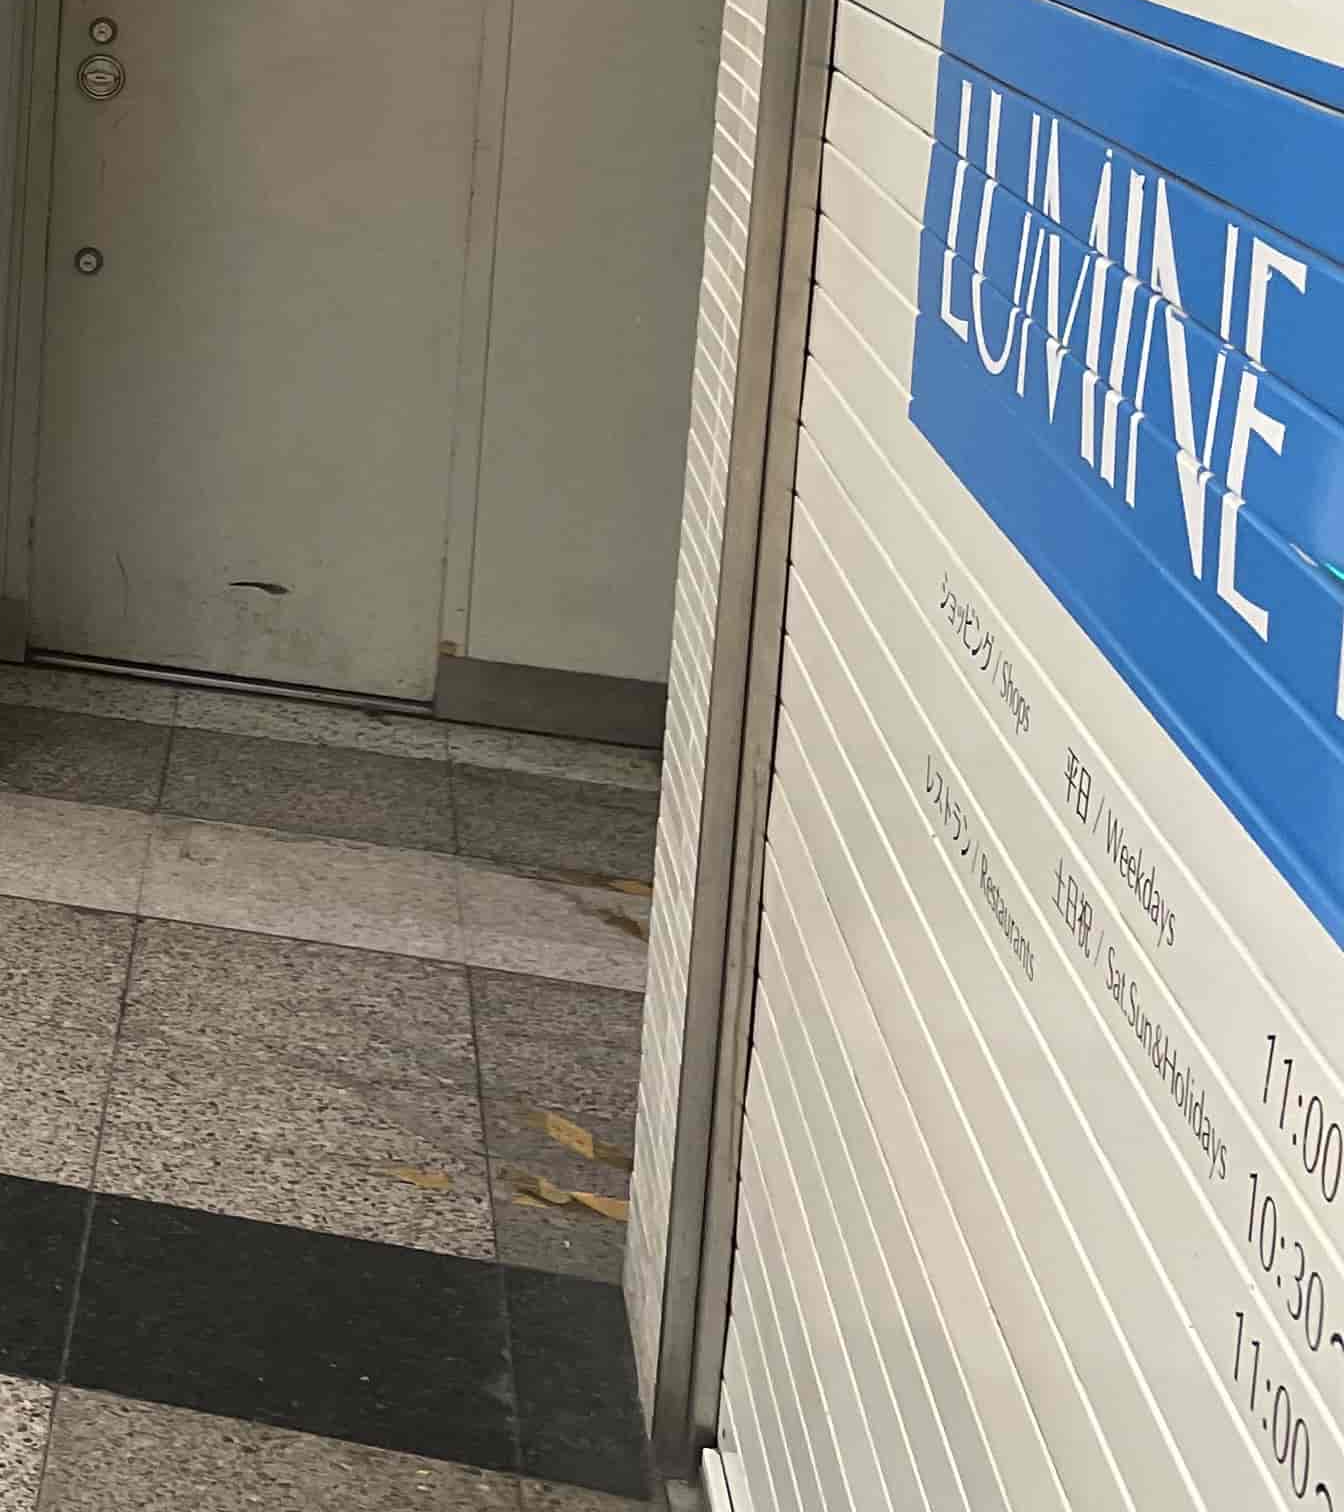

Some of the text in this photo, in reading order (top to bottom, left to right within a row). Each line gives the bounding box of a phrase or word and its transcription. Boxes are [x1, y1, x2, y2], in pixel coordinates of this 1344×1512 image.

[940, 80, 1309, 643] LUMINE
[940, 570, 995, 671] ショッピング
[1000, 660, 1031, 736] Shops
[925, 754, 972, 857] レストラン
[980, 852, 1036, 983] Restaurants
[1051, 856, 1094, 960] 土日祝
[1063, 746, 1093, 825] 平日
[1104, 807, 1176, 949] Weekdays
[1262, 1034, 1343, 1204] 11:00
